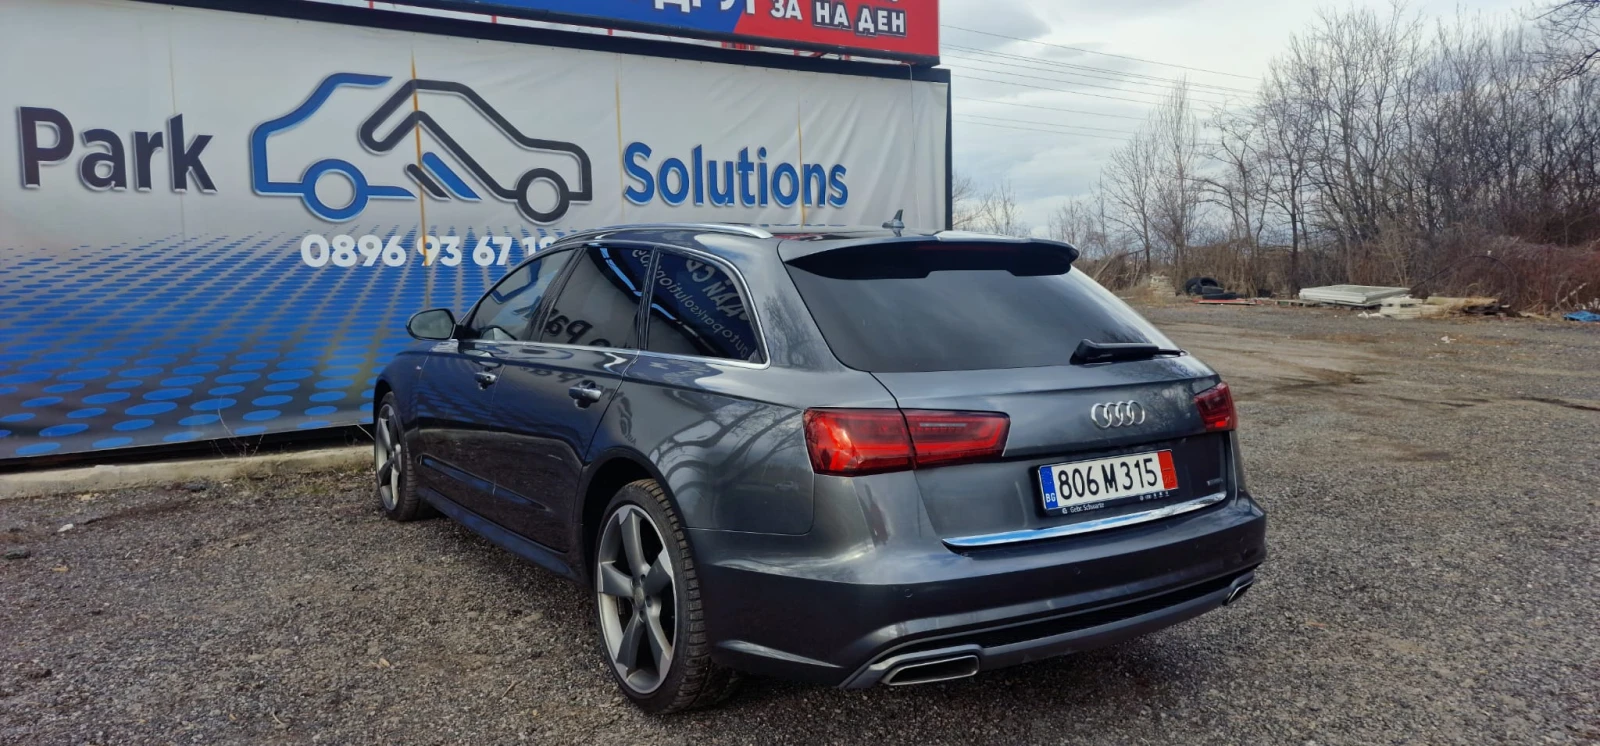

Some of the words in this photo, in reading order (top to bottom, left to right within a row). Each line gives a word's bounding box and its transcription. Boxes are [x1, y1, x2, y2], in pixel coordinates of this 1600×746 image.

[770, 0, 803, 20] ЗА
[815, 1, 849, 26] НА
[858, 8, 905, 33] ДЕН
[18, 106, 217, 193] Park
[623, 141, 849, 207] Solutions
[301, 234, 407, 267] 0896
[416, 235, 462, 266] 93
[473, 236, 512, 266] 67
[1045, 492, 1057, 502] BG
